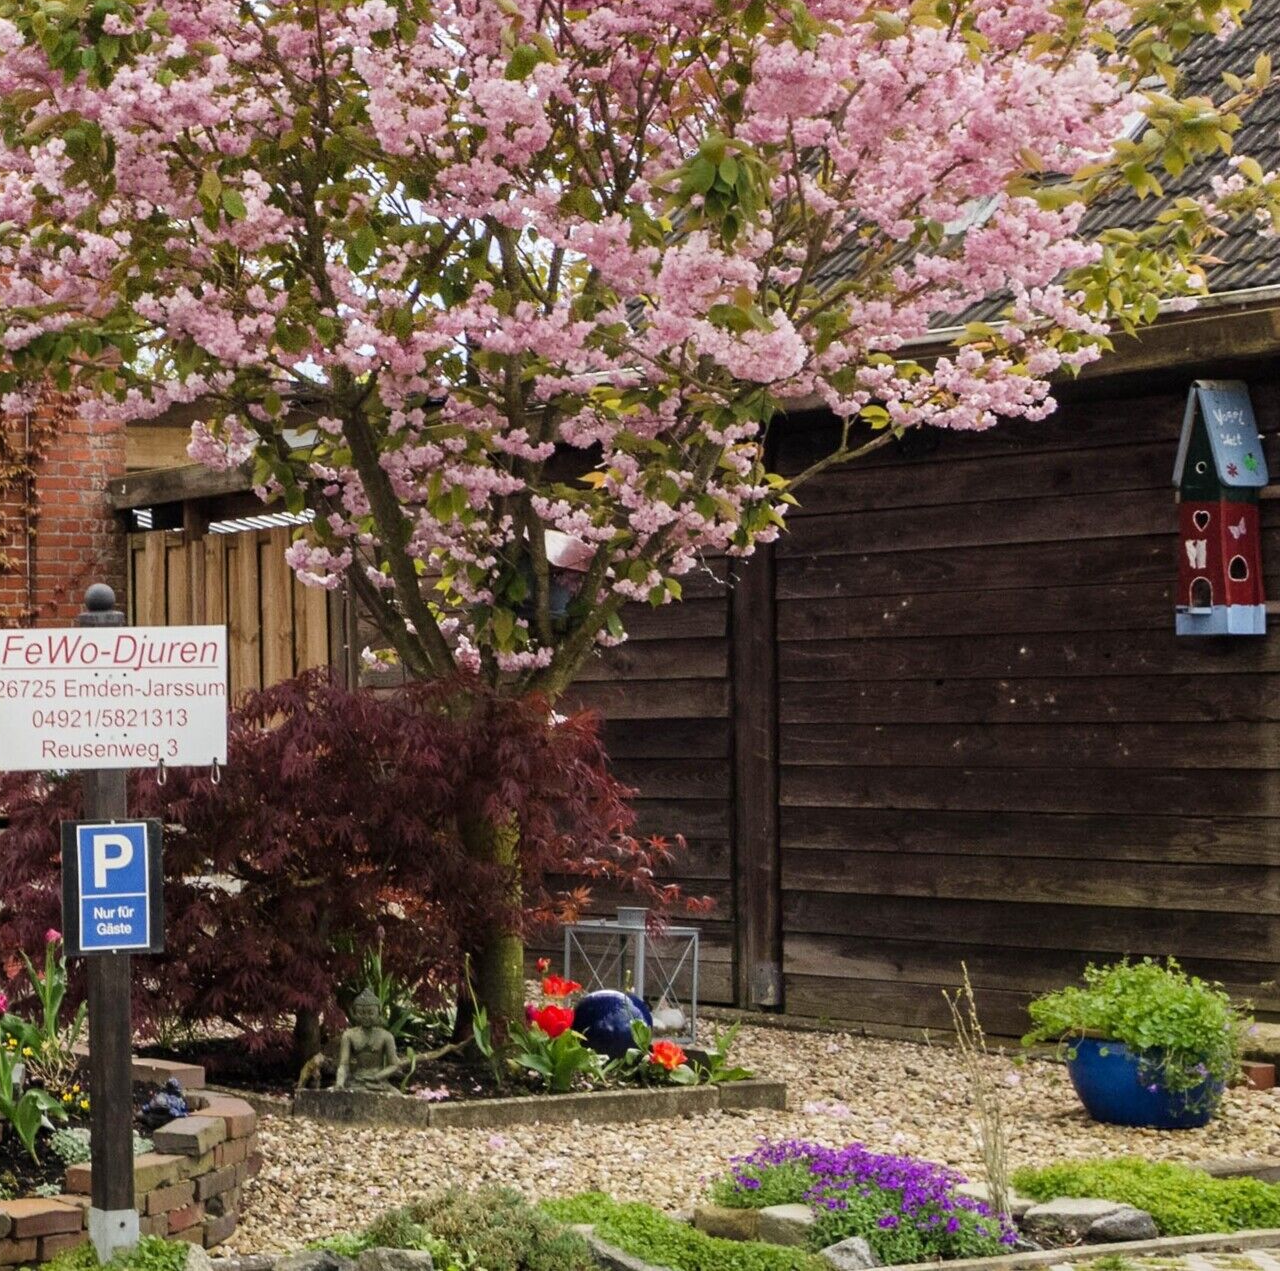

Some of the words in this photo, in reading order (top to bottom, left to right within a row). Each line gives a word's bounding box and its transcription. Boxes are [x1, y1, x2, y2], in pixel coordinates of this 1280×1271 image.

[2, 635, 218, 671] FeWo-Djuren
[64, 679, 225, 698] Emden-Jarssum
[32, 709, 188, 728] 04921/5821313
[42, 740, 159, 761] Reusenweg
[167, 739, 179, 757] 3
[93, 834, 133, 888] P
[94, 907, 115, 919] Nur
[117, 906, 134, 918] für
[96, 922, 132, 935] Gäste
